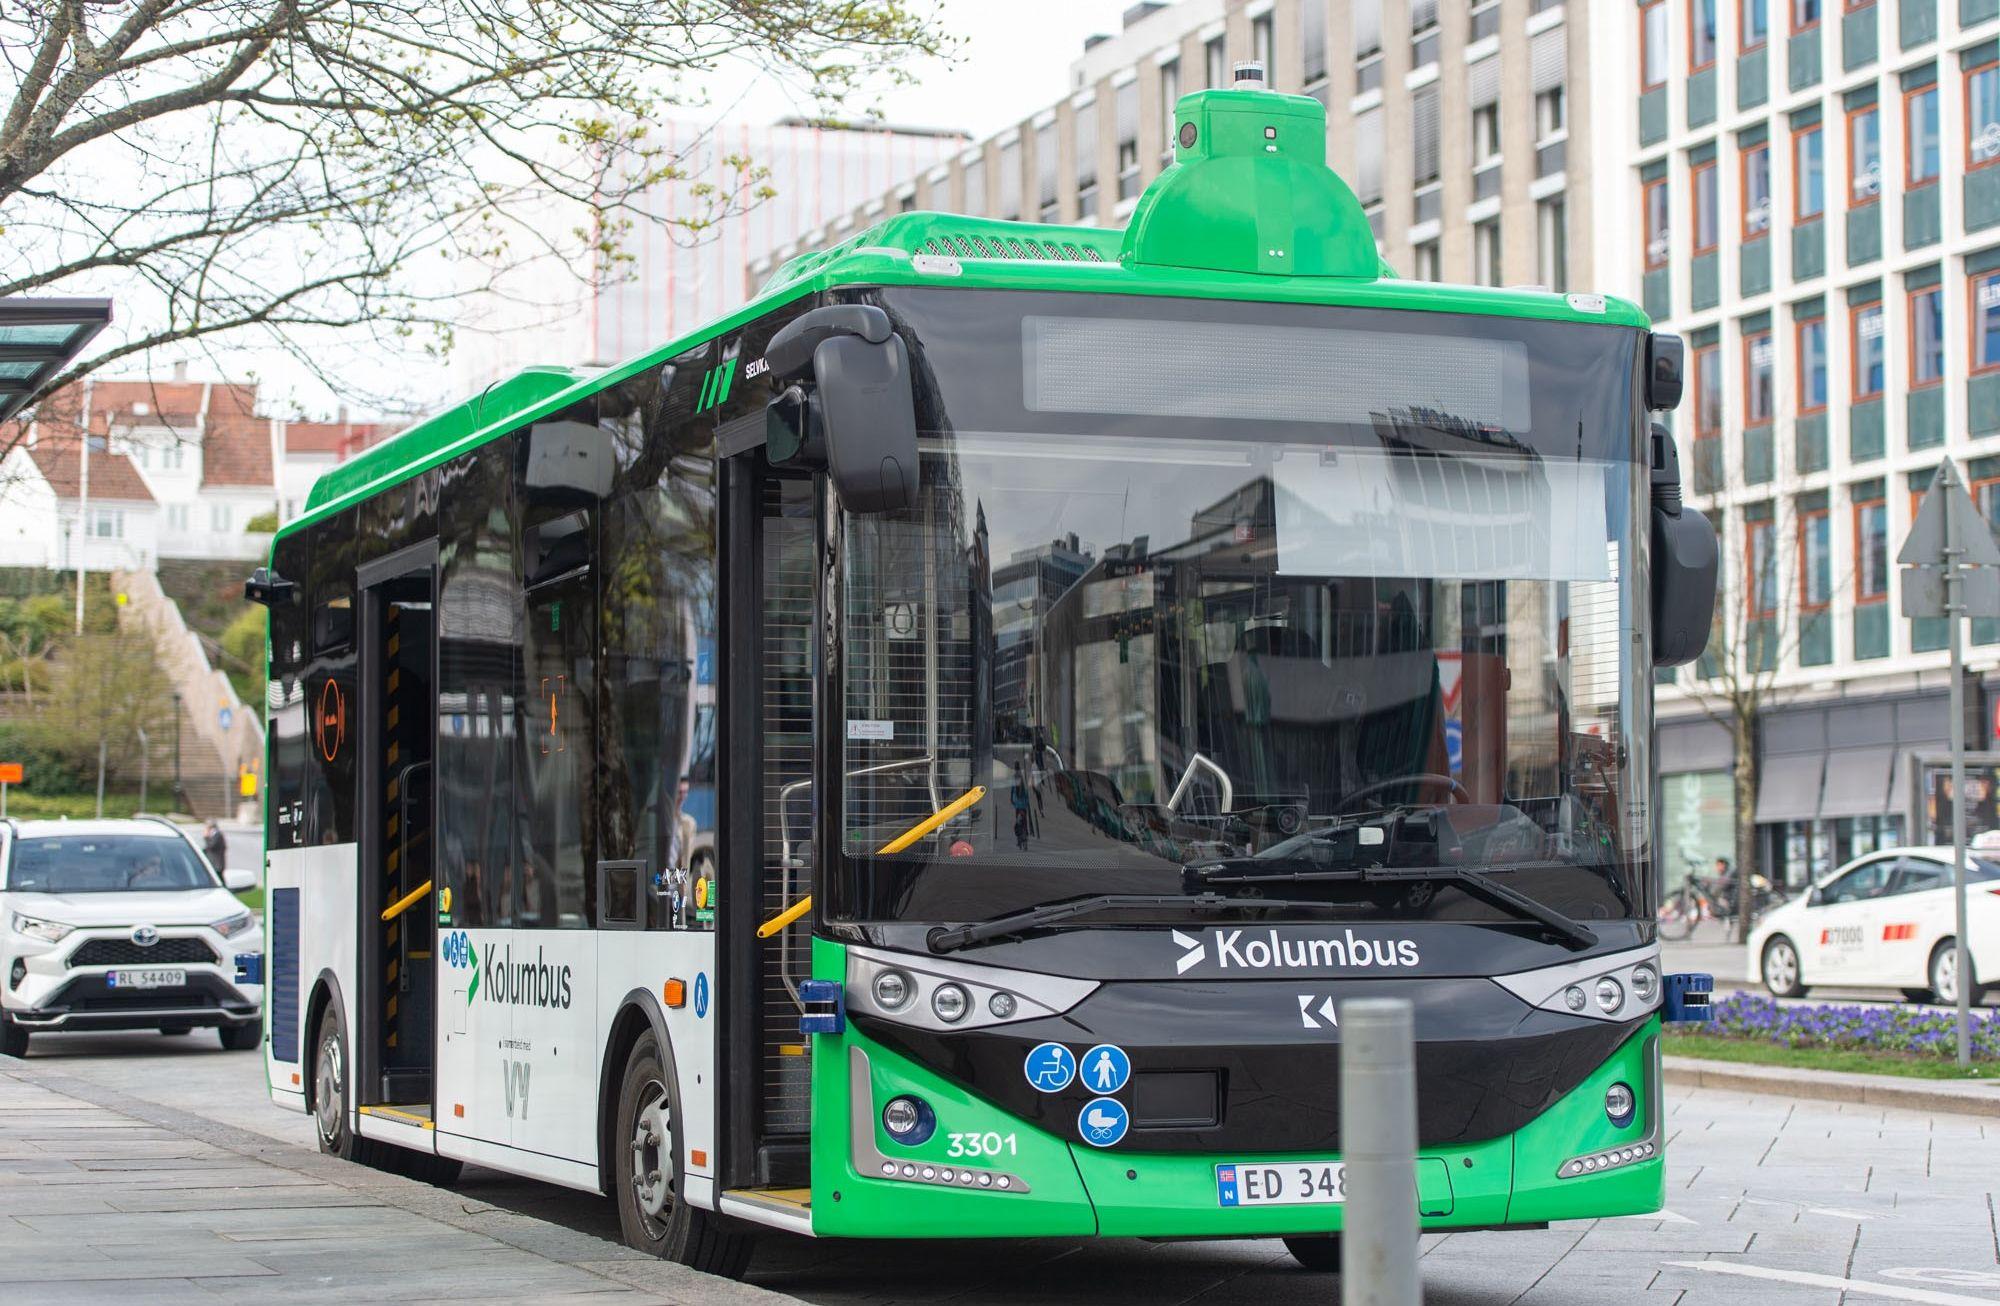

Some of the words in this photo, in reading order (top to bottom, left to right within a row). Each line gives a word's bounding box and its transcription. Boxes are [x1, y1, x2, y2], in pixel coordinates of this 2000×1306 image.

[1215, 929, 1420, 968] Kolumbus
[119, 972, 134, 985] RL
[142, 971, 182, 985] 54409
[485, 943, 571, 1010] Kolumbus
[947, 1132, 1017, 1157] 3301
[1224, 1190, 1234, 1200] N
[1245, 1169, 1282, 1199] ED
